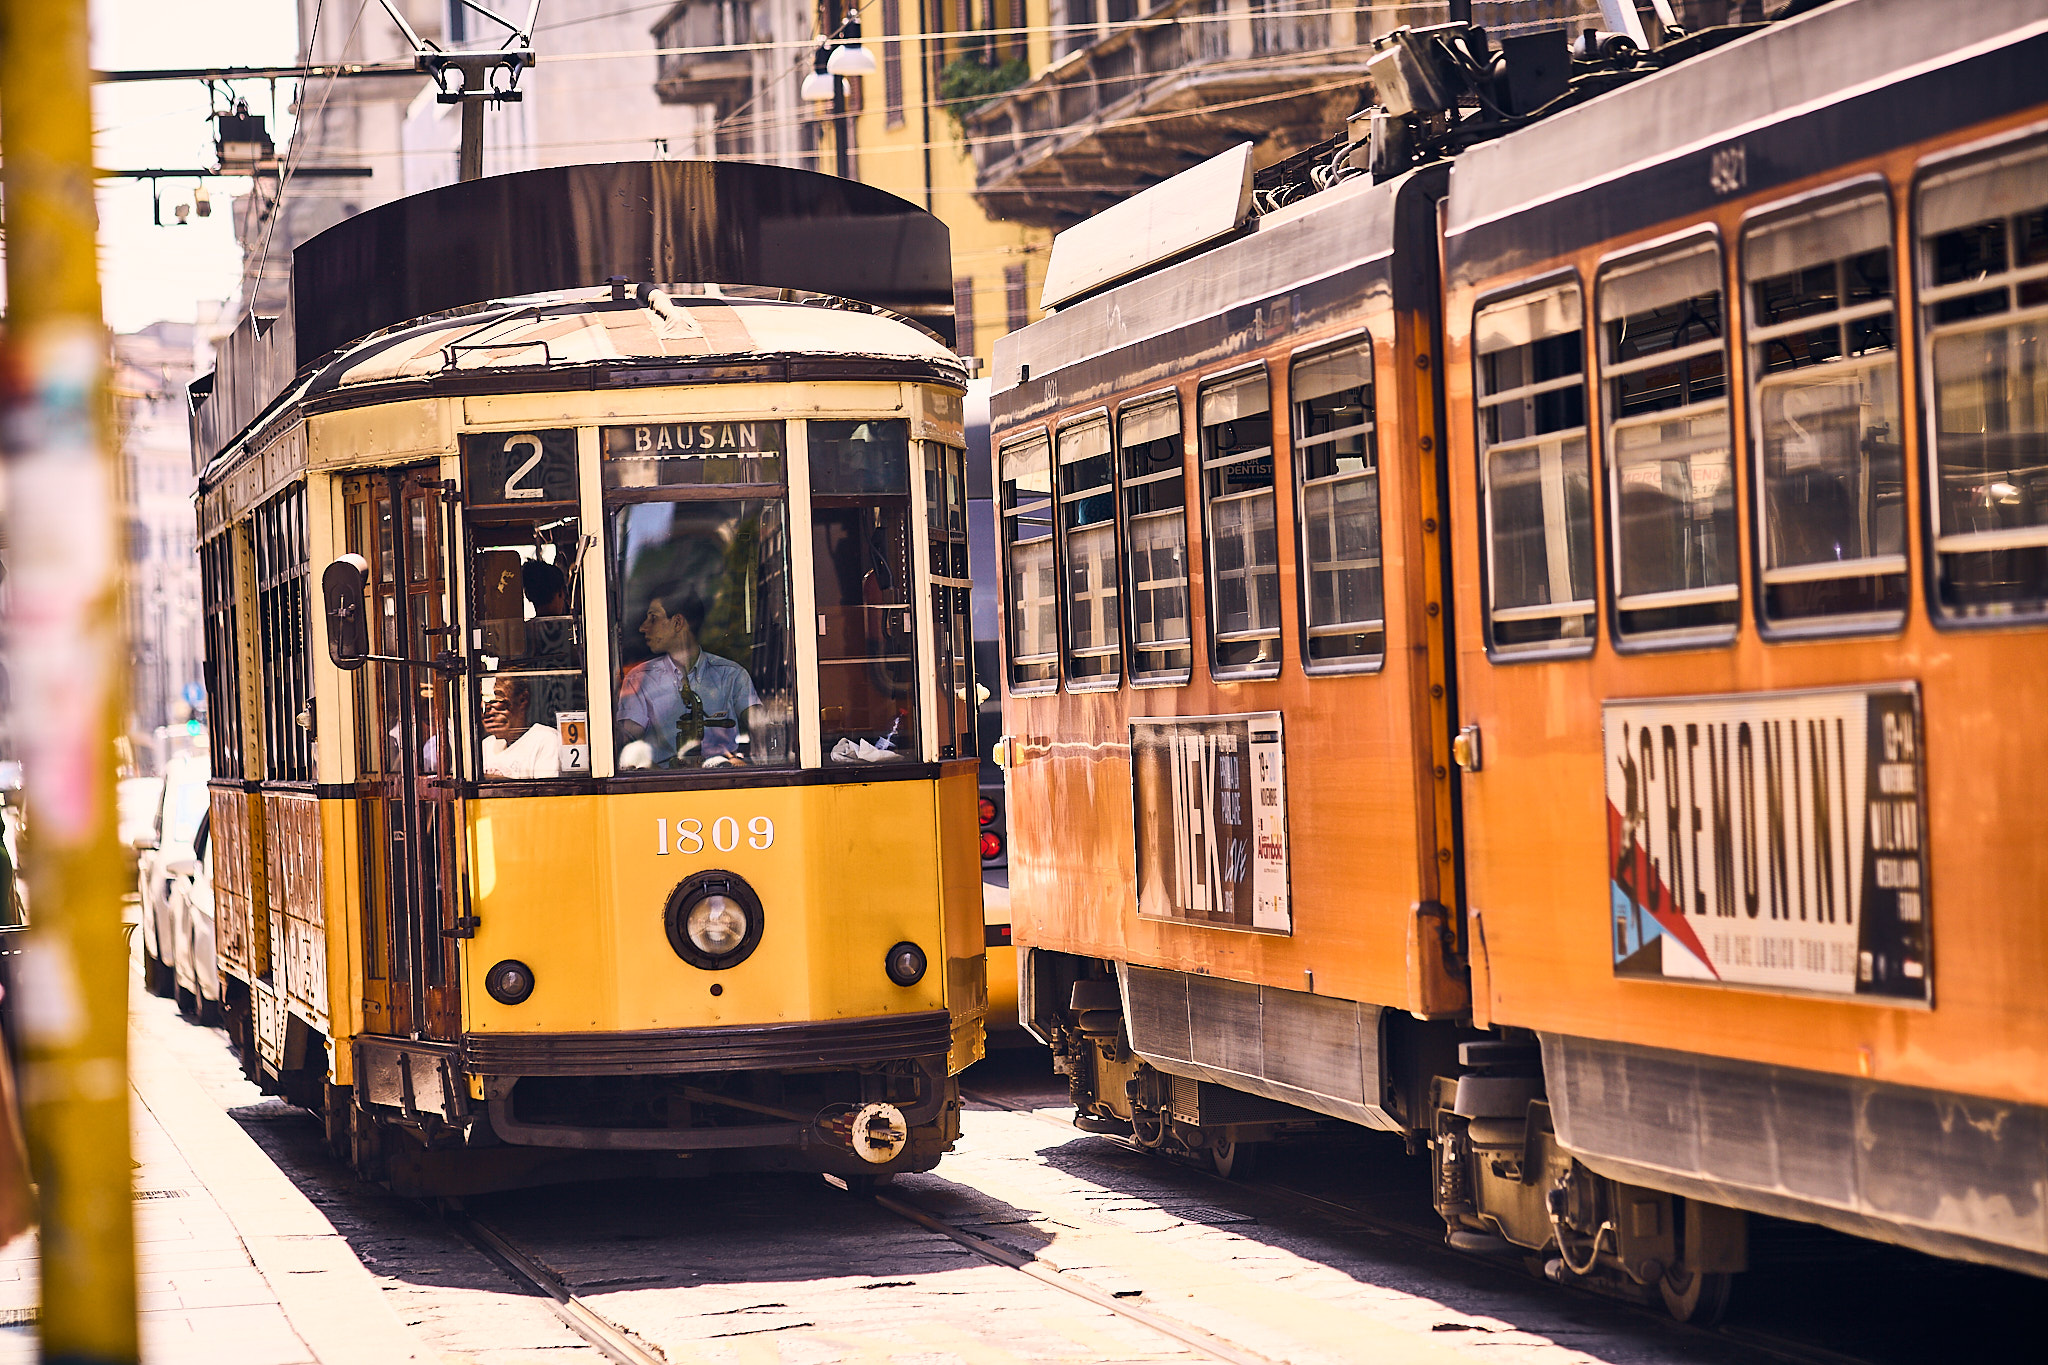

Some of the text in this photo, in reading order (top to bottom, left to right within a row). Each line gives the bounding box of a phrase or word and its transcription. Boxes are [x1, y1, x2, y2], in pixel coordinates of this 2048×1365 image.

[635, 423, 757, 451] BAUSAN
[503, 433, 544, 500] 2
[1227, 464, 1273, 475] DENTIST
[567, 723, 579, 744] 9
[570, 748, 581, 768] 2
[656, 815, 775, 856] 1809
[1169, 734, 1224, 912] NEK
[1639, 717, 1853, 925] CREMONINI
